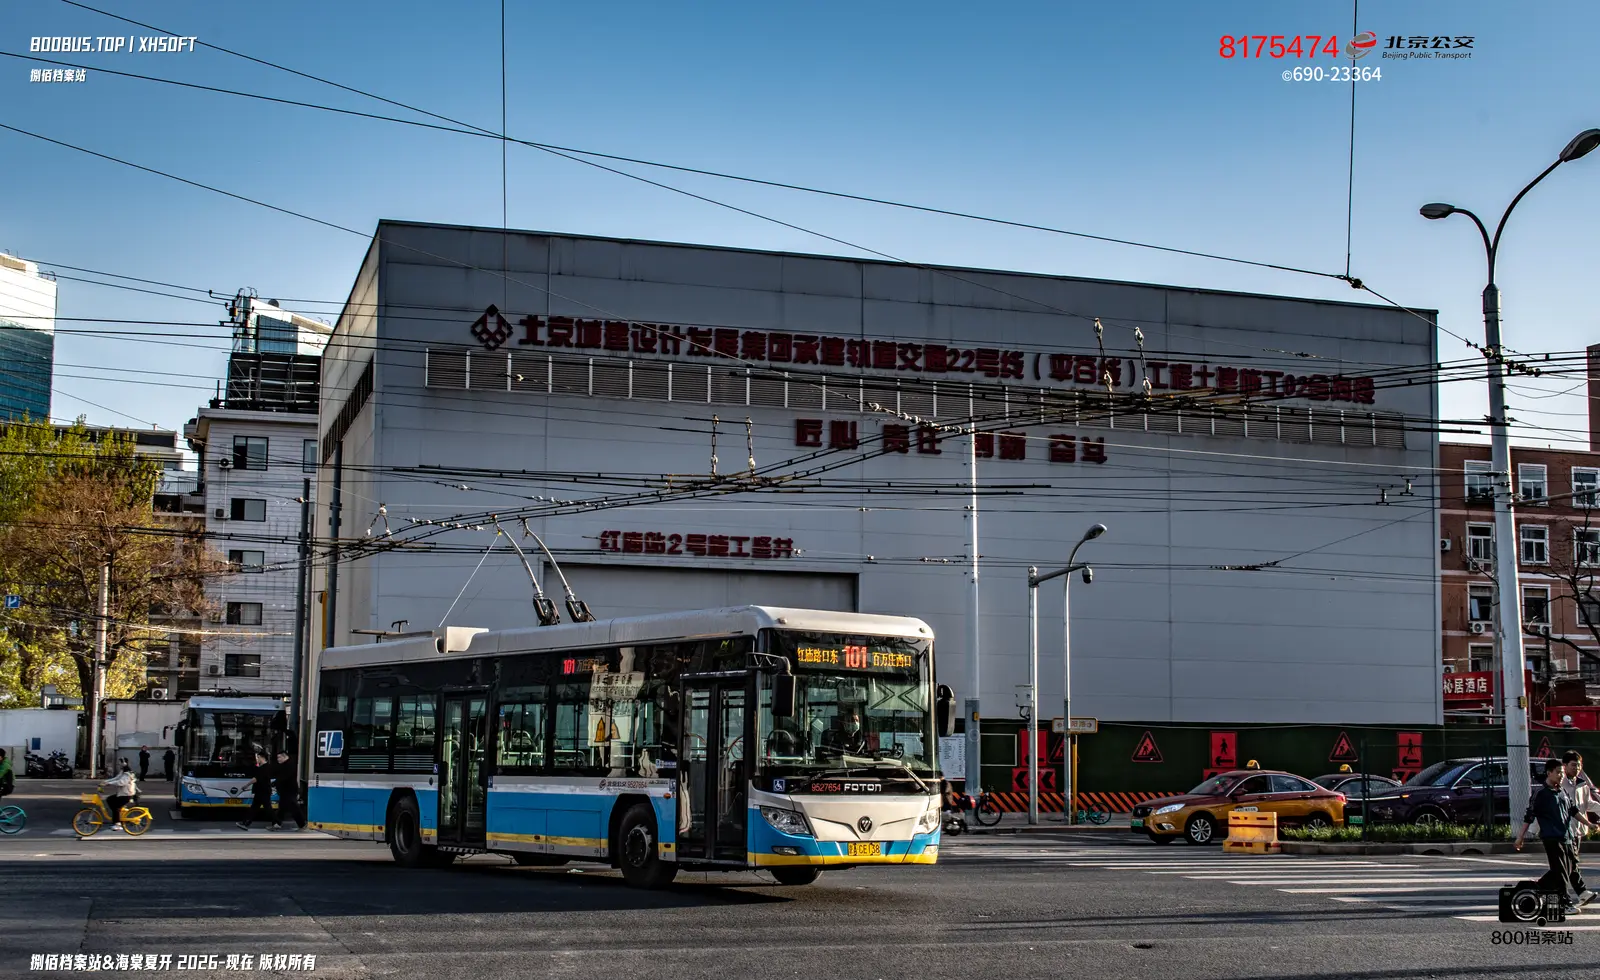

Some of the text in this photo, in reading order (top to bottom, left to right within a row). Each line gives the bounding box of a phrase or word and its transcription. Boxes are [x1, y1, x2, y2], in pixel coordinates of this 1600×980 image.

[796, 418, 859, 450] 匠心
[883, 423, 942, 454] 责任
[1049, 434, 1108, 464] 奋斗
[797, 646, 912, 668] 红庙路口东 101 百万庄西口
[563, 659, 576, 674] 101
[811, 783, 882, 792] 9527654 FOTON
